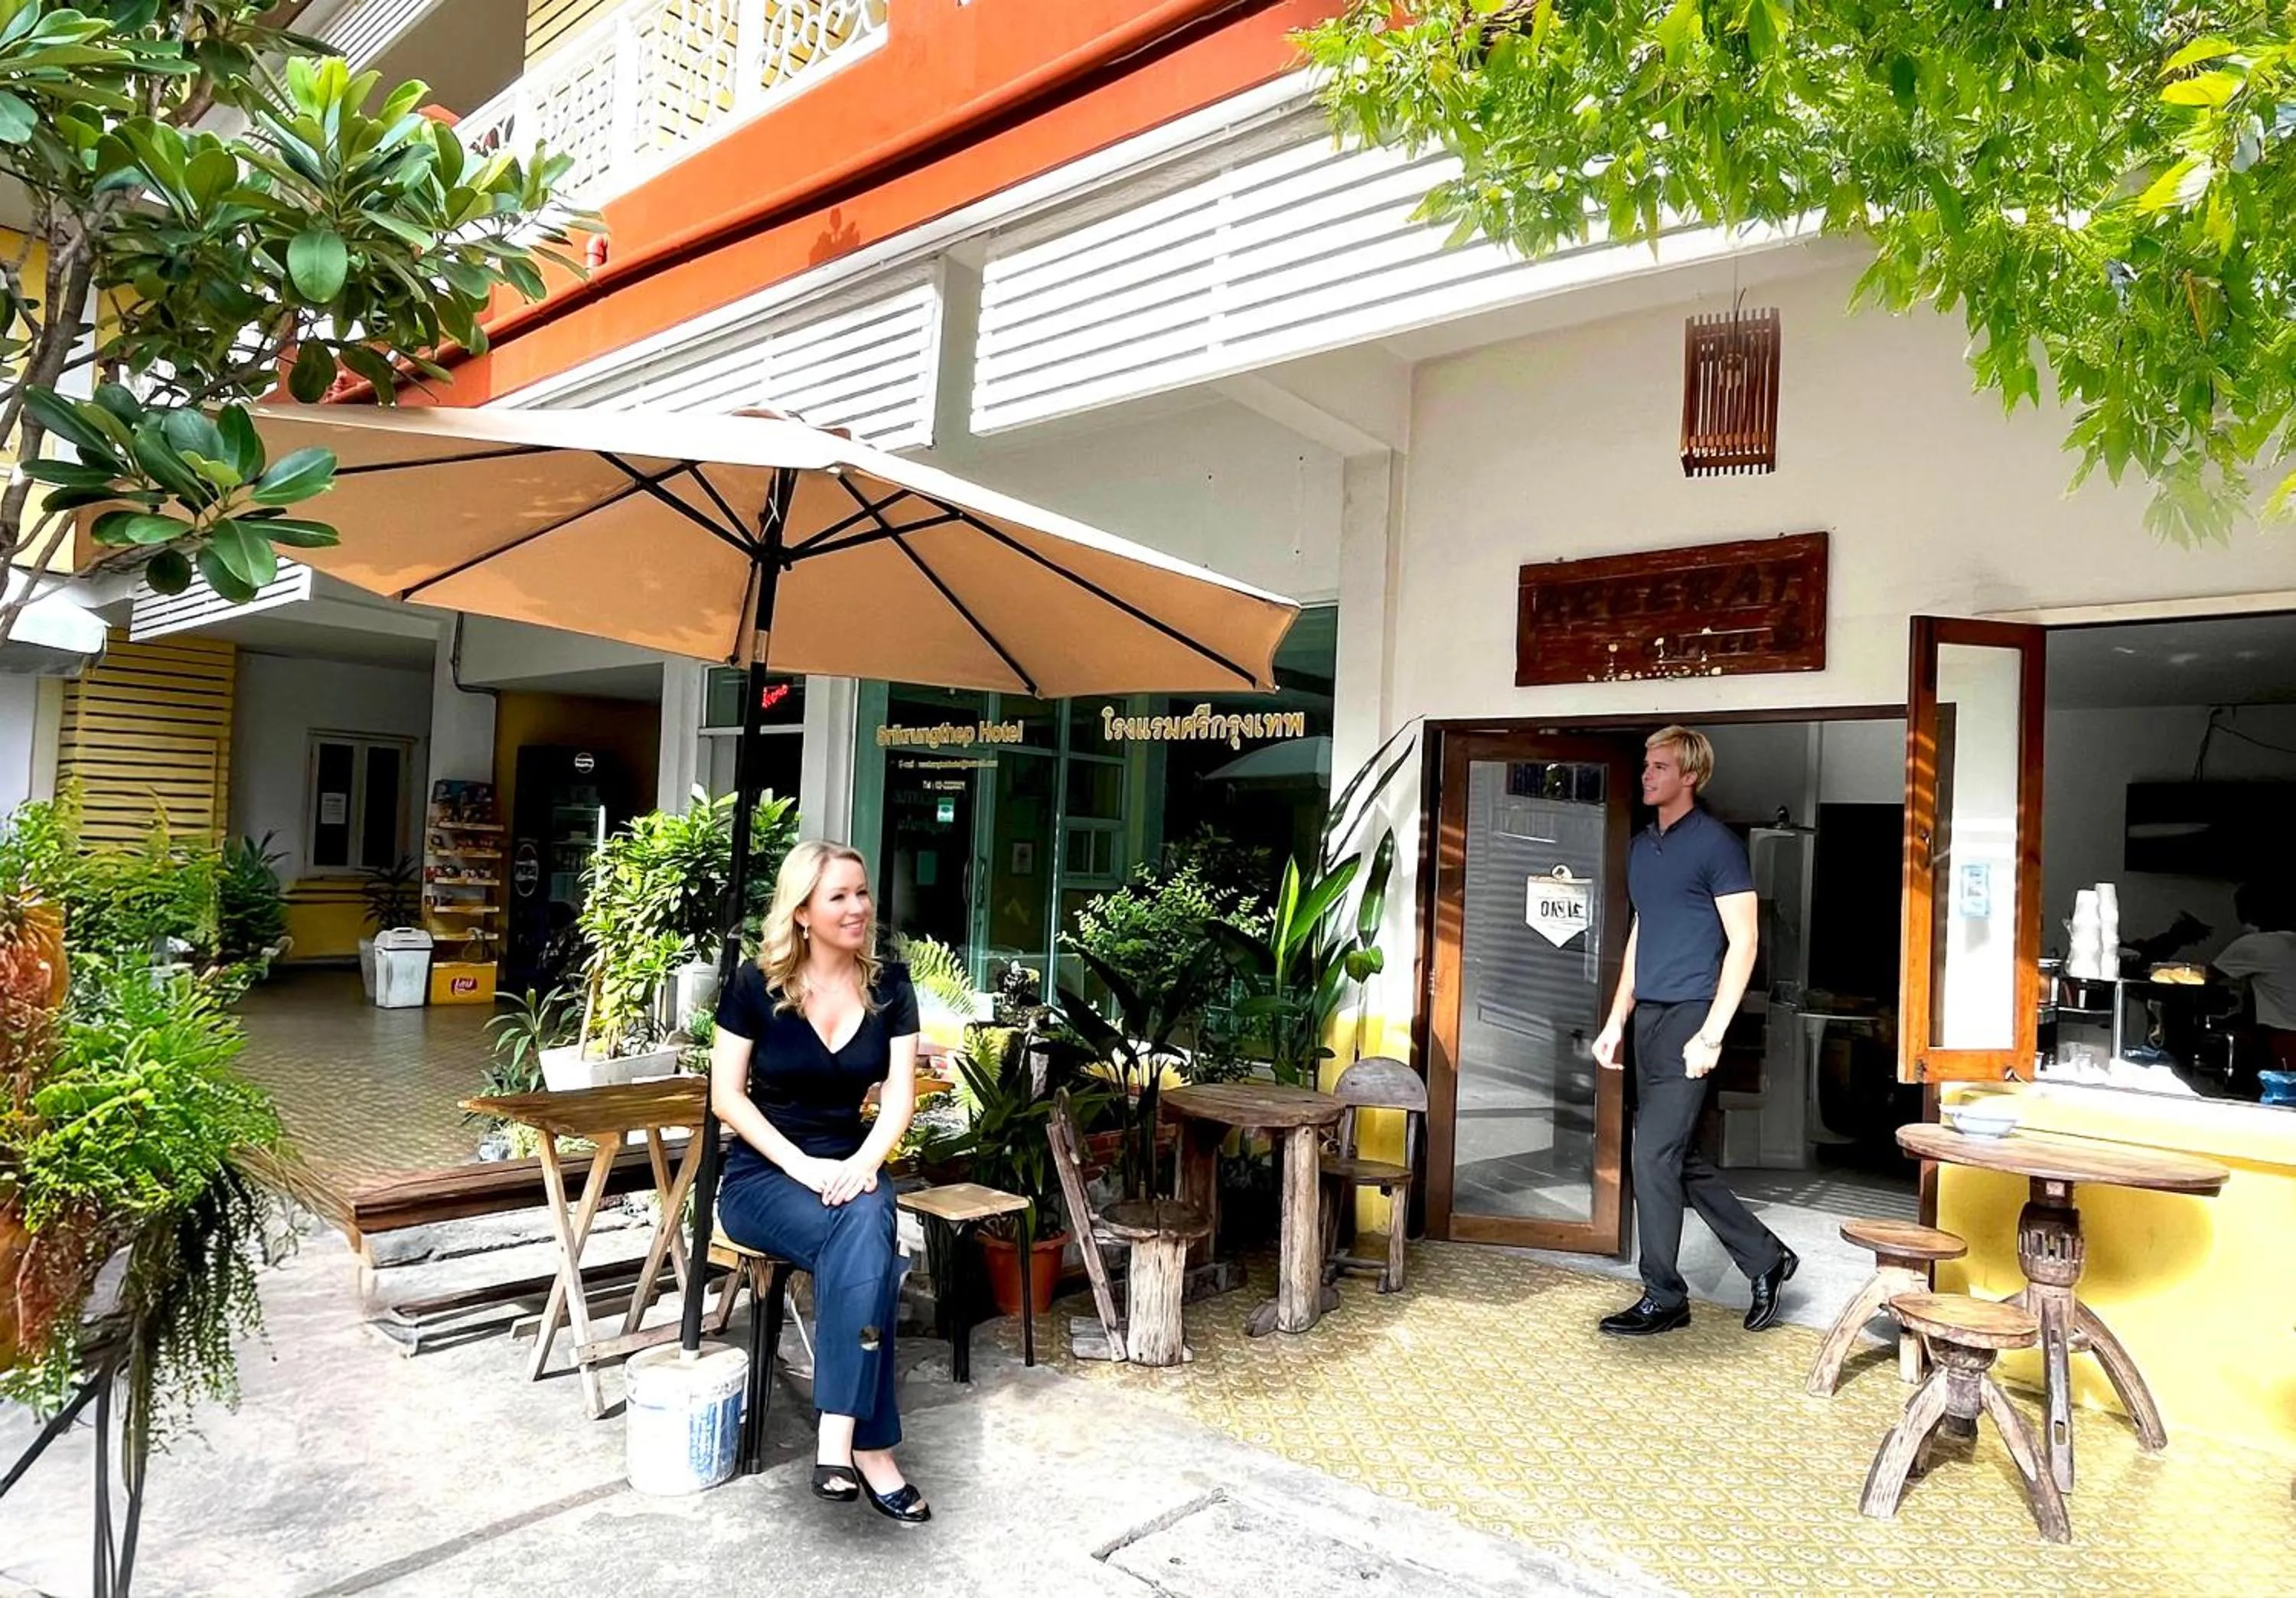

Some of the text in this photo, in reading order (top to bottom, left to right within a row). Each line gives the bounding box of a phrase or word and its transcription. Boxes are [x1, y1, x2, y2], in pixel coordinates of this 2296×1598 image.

[978, 719, 1024, 743] Hotel
[1101, 703, 1305, 750] โรงแรมศรีกรุงเทพ
